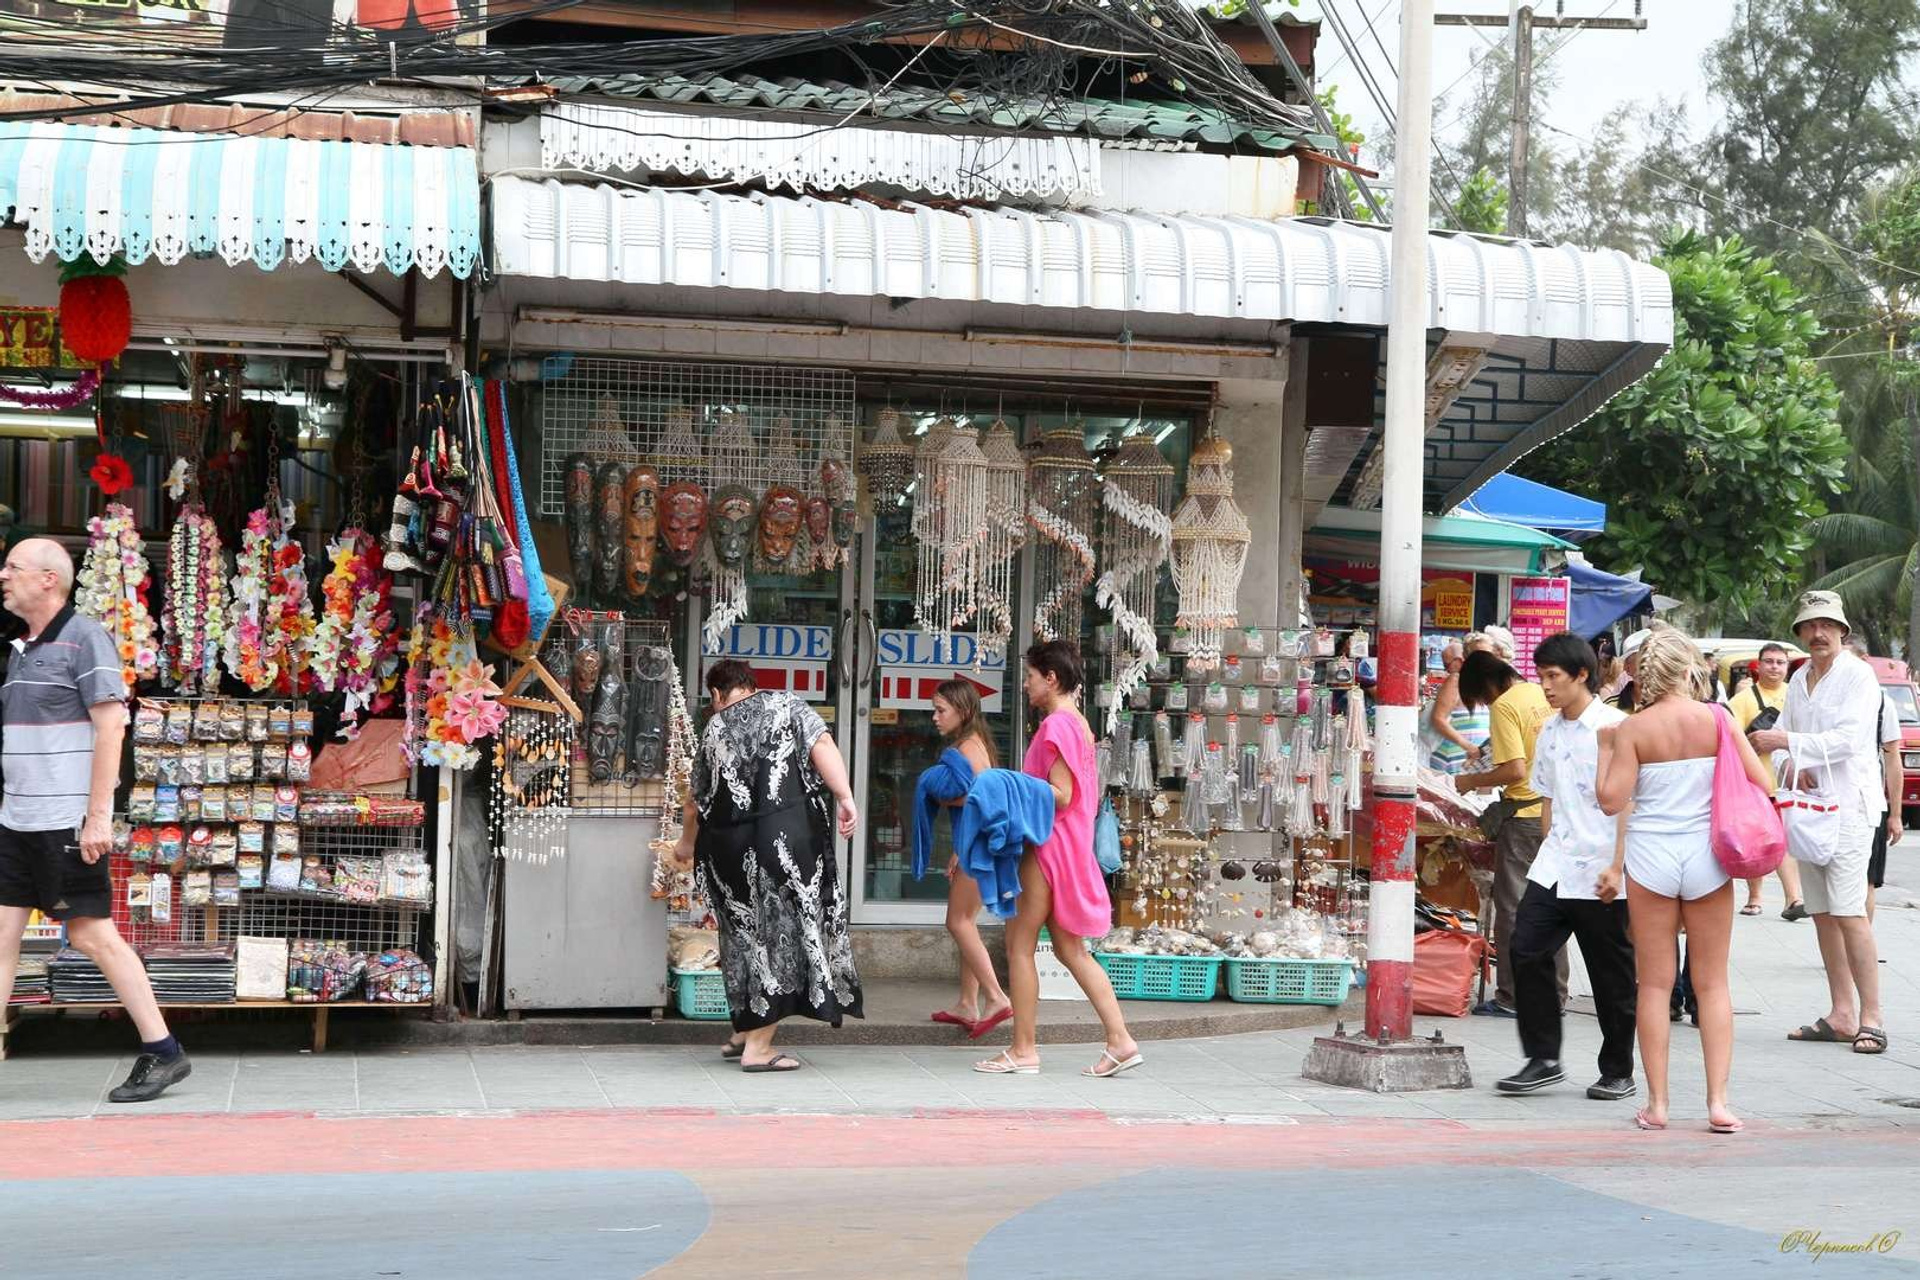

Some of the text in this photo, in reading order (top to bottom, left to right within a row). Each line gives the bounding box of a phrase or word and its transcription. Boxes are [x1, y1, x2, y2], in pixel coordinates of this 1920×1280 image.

[1438, 594, 1472, 608] LAUNDRY
[1440, 606, 1469, 618] SERVICE
[880, 632, 1004, 667] SLIDE
